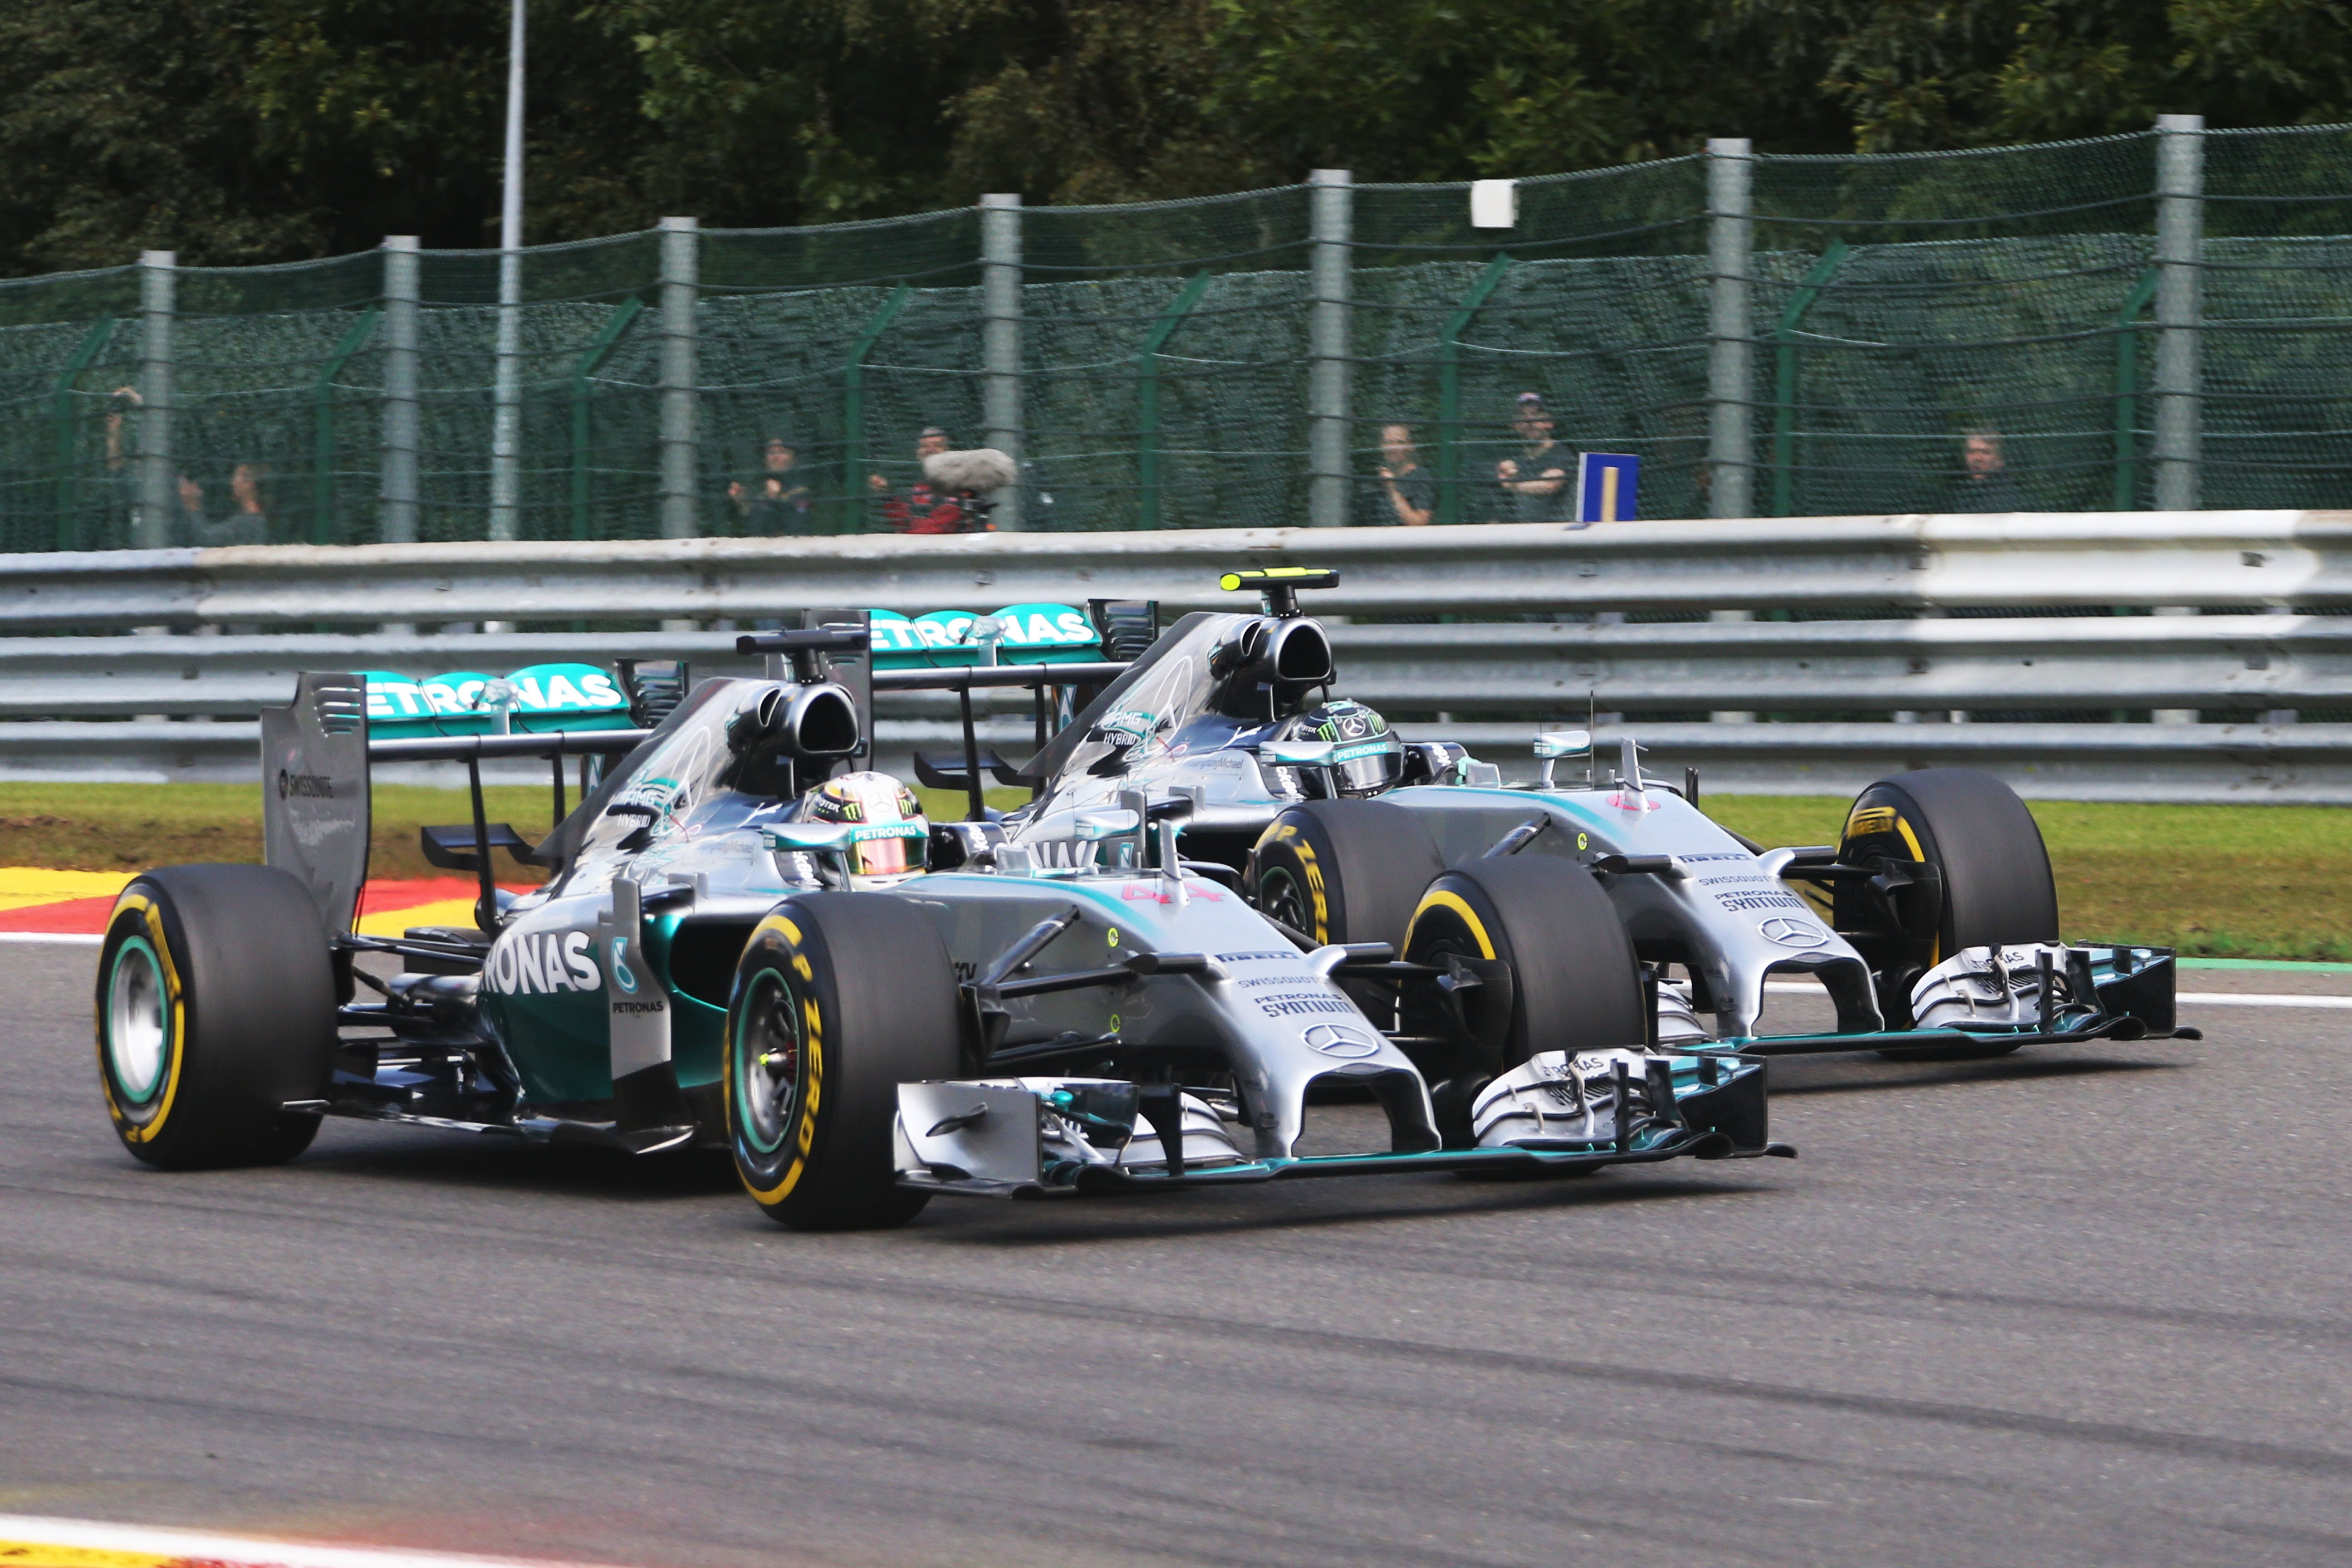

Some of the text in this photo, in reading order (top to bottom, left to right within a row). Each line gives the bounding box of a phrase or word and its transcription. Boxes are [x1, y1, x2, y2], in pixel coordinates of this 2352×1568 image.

[870, 613, 1094, 649] ETRONAS
[366, 674, 622, 715] ETRONAS
[1103, 732, 1137, 745] HYBRID
[1337, 744, 1387, 760] PETRONAS
[855, 825, 917, 840] PETRONAS
[1714, 890, 1793, 900] PETRONAS
[481, 931, 602, 995] RONAS
[1238, 976, 1328, 989] SWISSQUOT
[1254, 993, 1342, 1004] PETRONAS
[612, 1000, 664, 1014] PETRONAS
